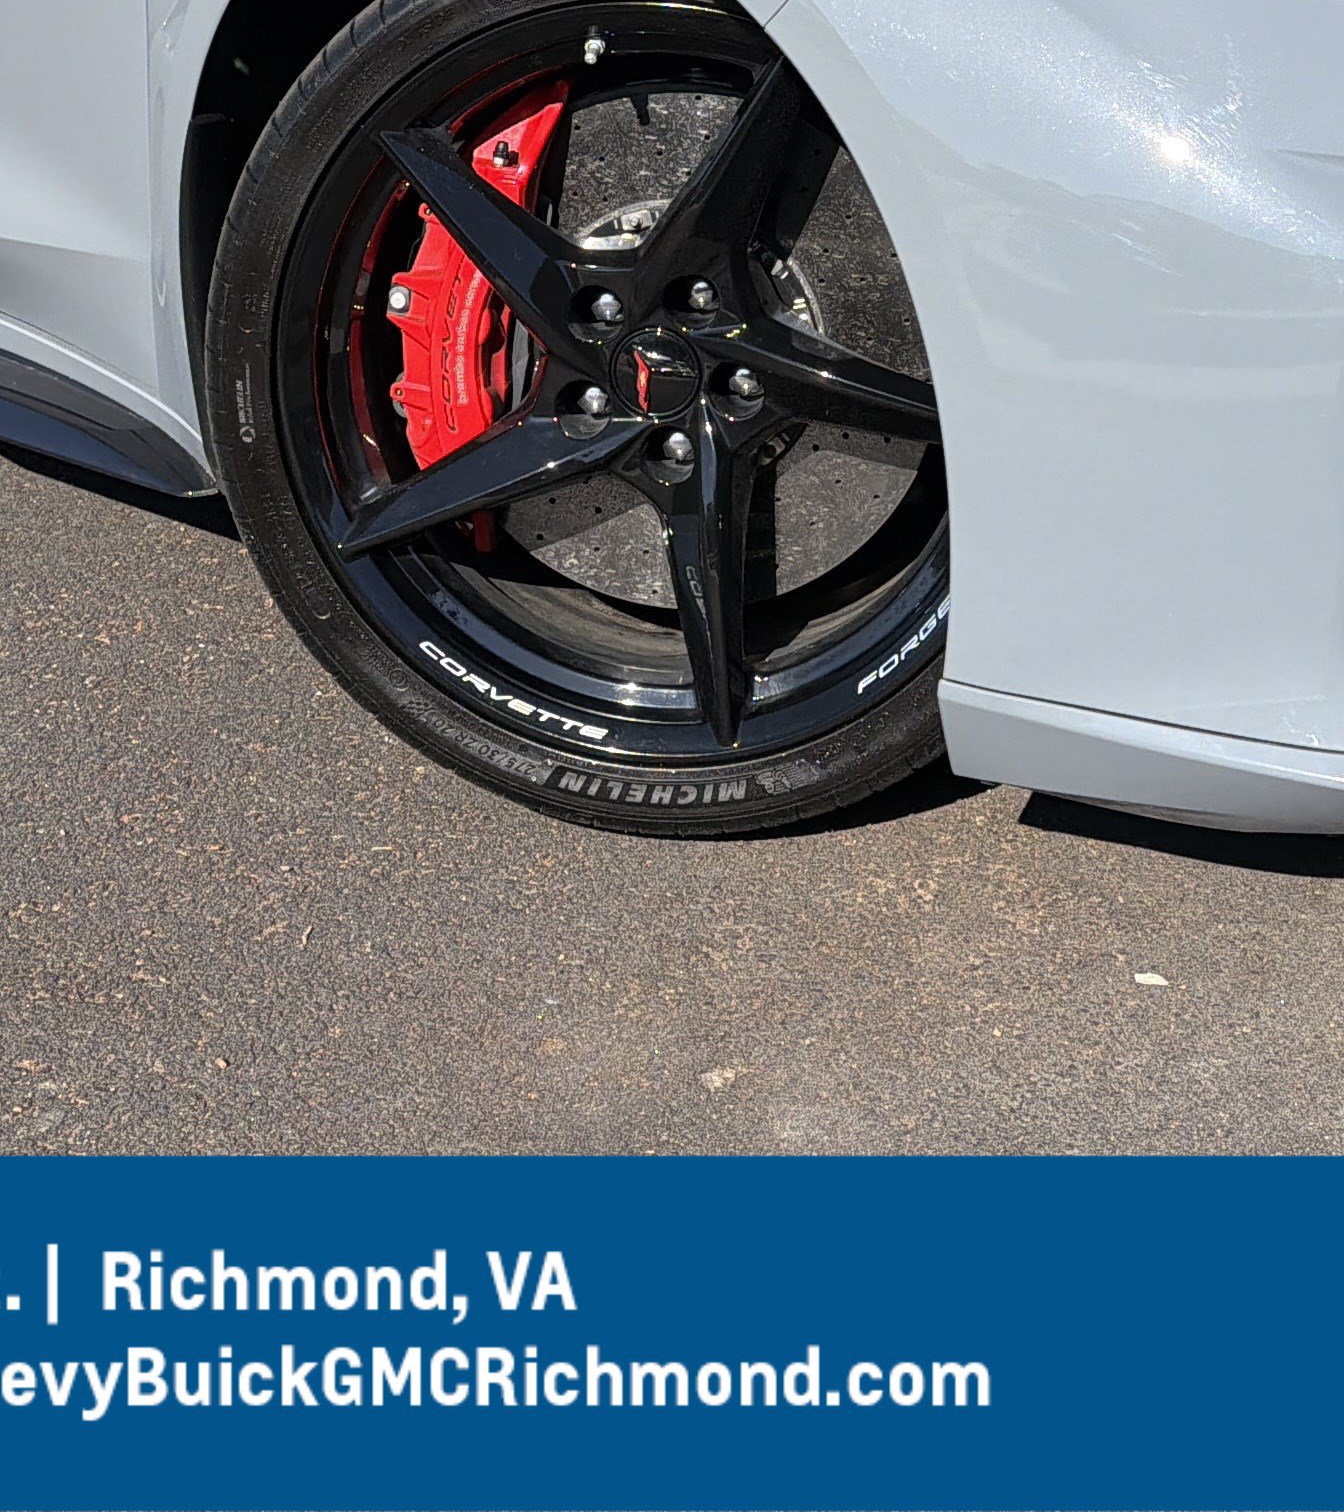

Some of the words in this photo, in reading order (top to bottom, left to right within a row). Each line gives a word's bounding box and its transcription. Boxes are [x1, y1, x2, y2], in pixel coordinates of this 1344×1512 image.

[441, 254, 466, 432] CORVET
[419, 641, 609, 740] CORVETTE
[857, 593, 953, 695] FORGE
[558, 771, 748, 805] MICHELIN
